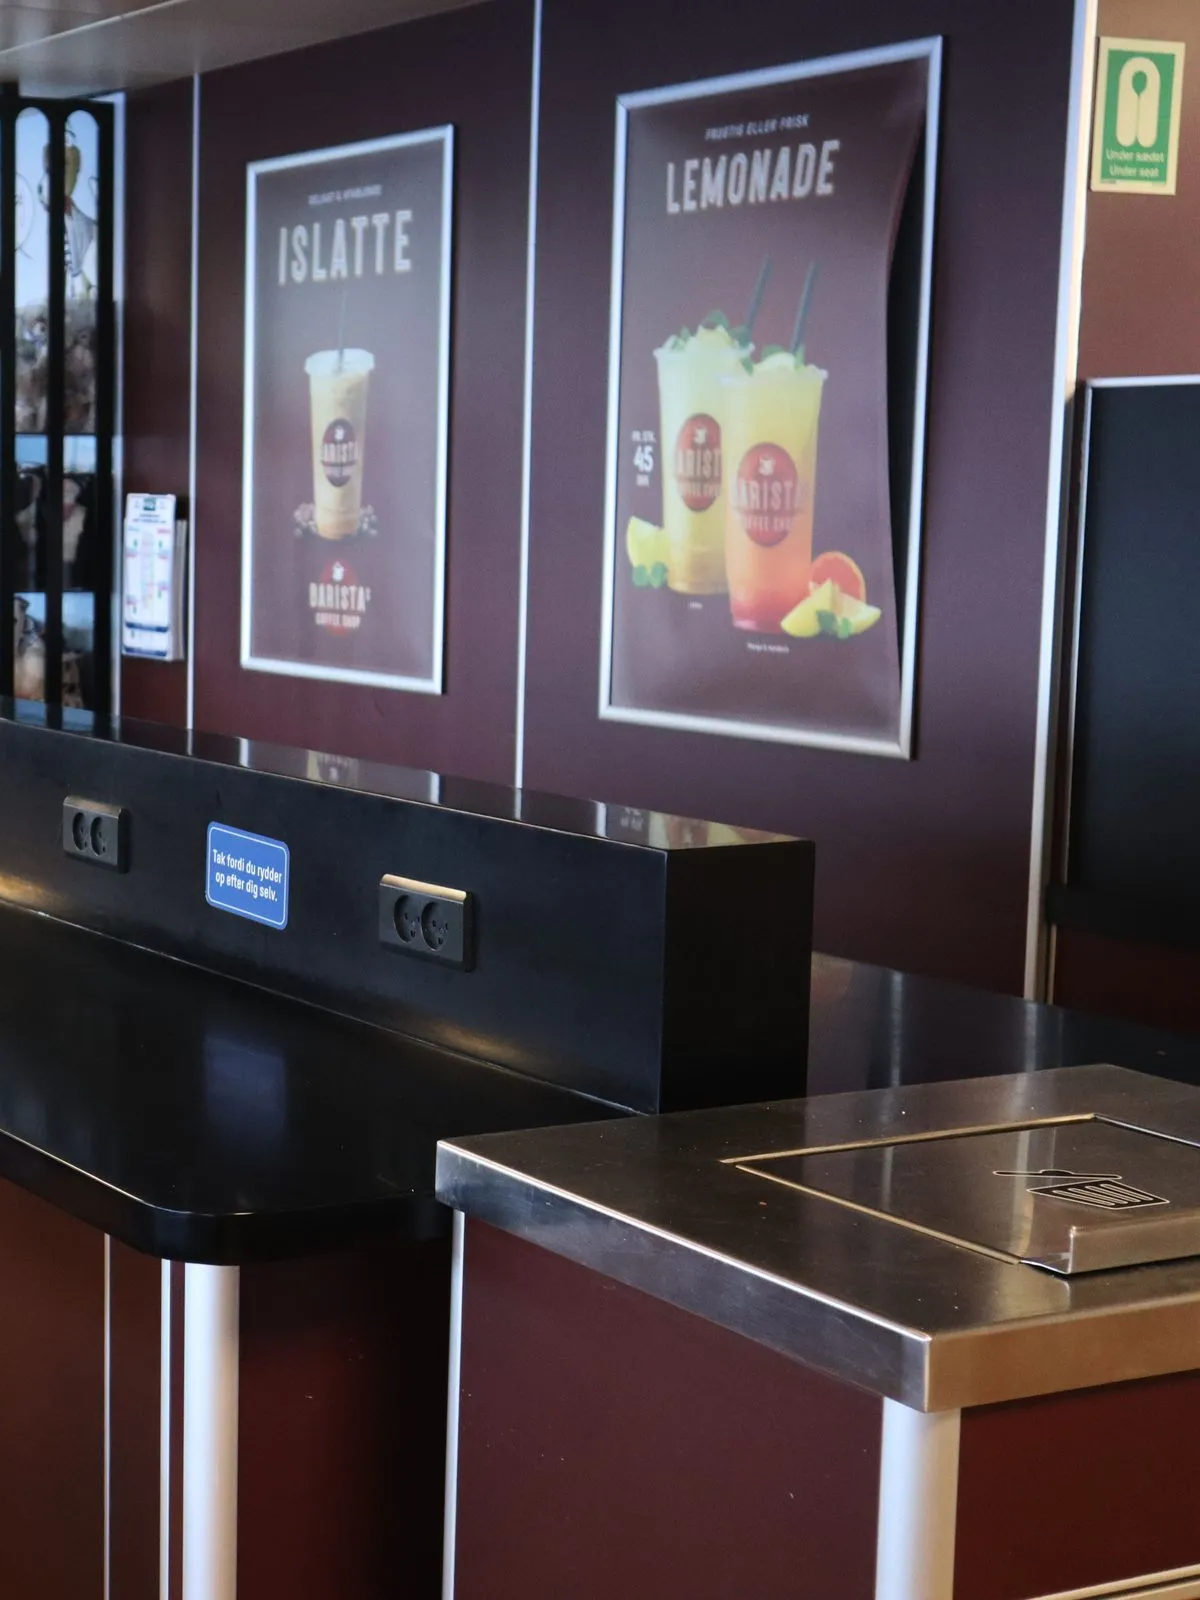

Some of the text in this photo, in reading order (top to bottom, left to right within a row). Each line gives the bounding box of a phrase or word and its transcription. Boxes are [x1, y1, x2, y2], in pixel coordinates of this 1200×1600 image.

[746, 118, 777, 136] ELLER
[1106, 148, 1134, 160] Under
[666, 139, 841, 214] LEMONADE
[1109, 164, 1159, 177] Under seat
[278, 209, 413, 287] ISLATTE
[633, 445, 654, 473] 45
[212, 848, 283, 883] Tak fordi du rydder
[215, 872, 278, 902] op efter dig selv.
